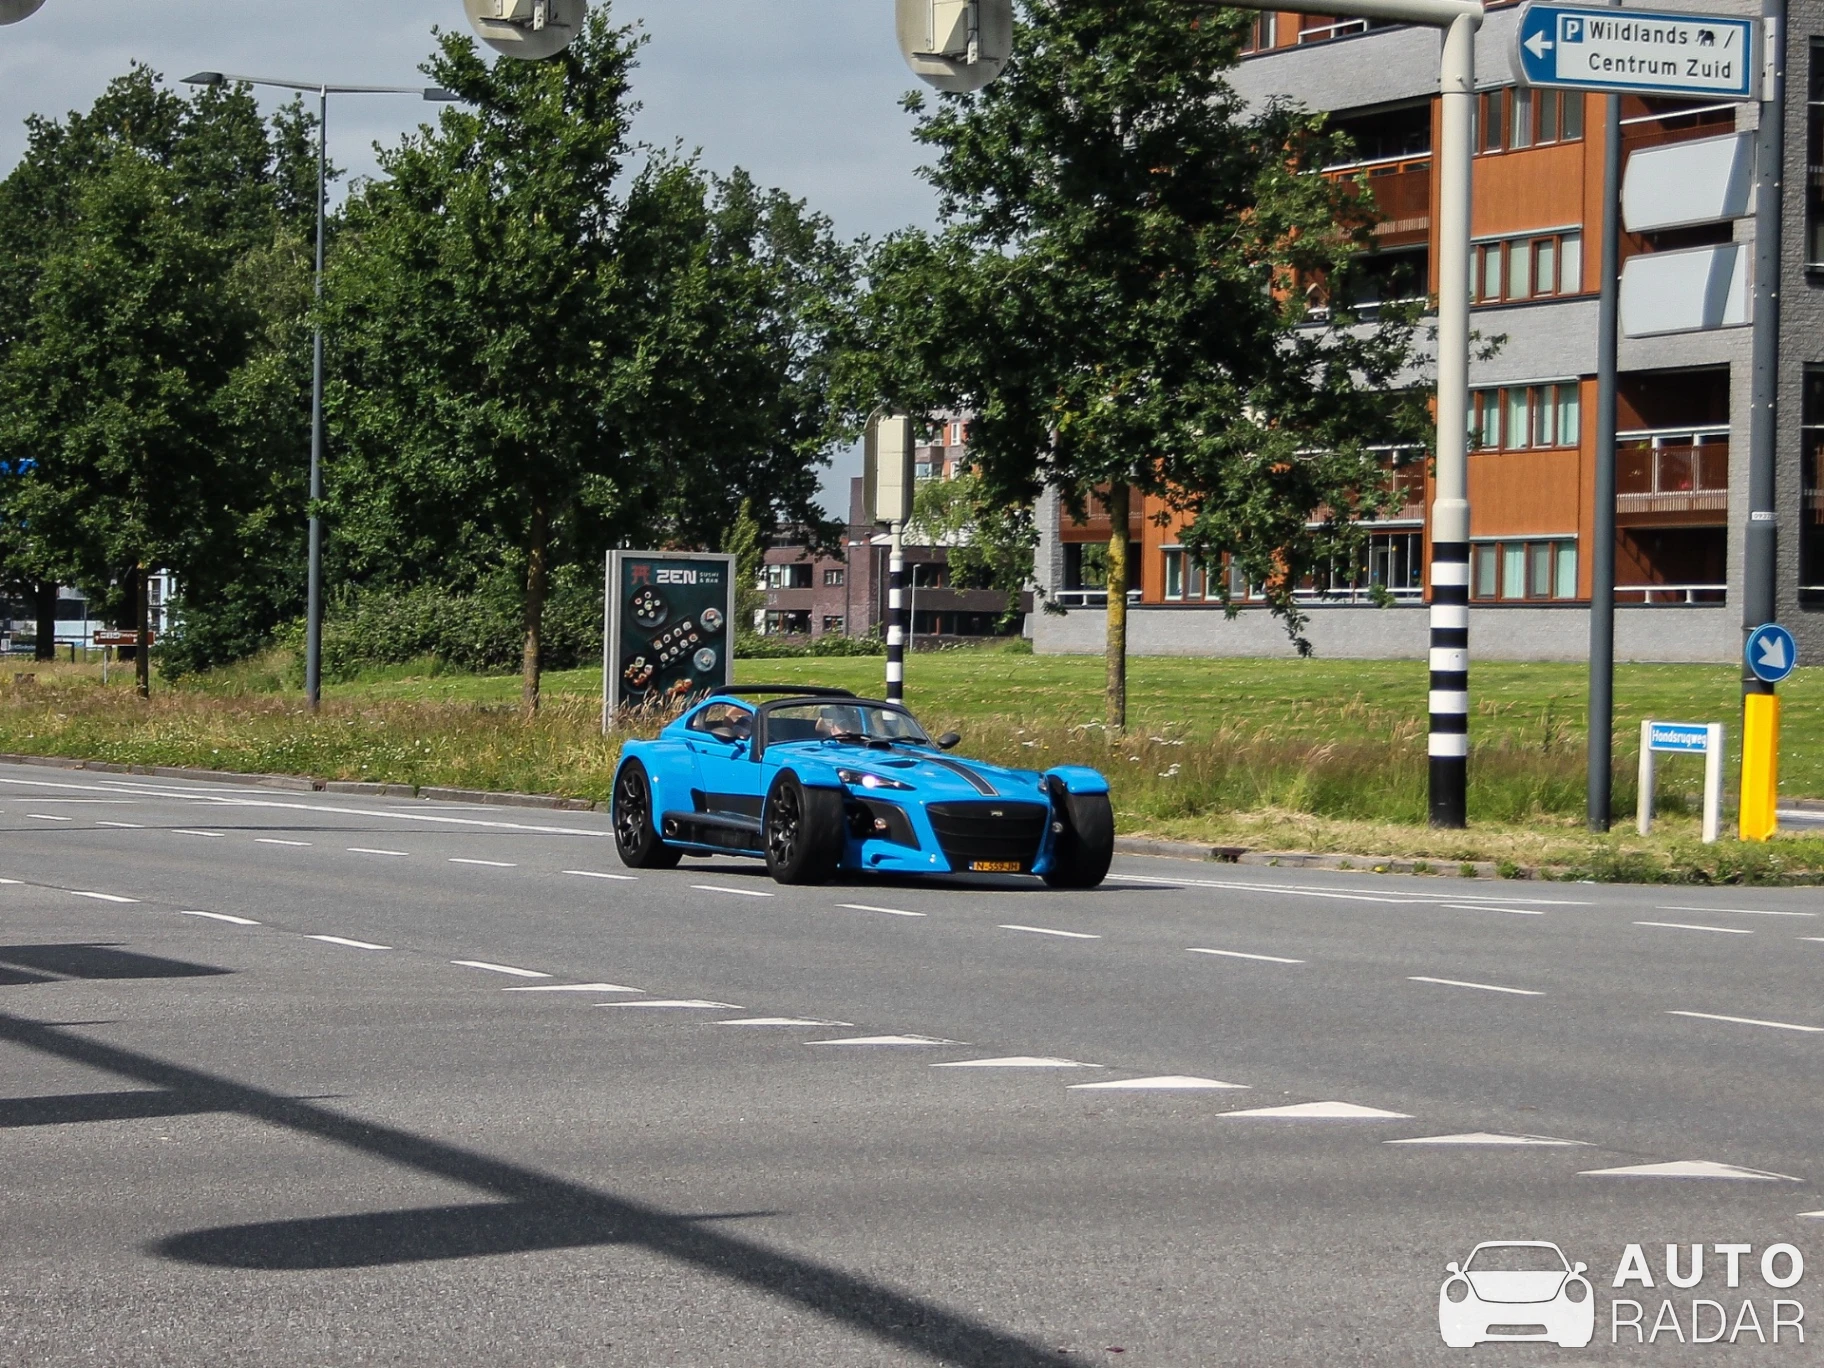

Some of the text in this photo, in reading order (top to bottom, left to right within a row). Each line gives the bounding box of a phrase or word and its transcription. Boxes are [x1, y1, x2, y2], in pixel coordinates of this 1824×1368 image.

[1566, 20, 1580, 40] P
[1589, 21, 1688, 45] Wildlands
[1589, 52, 1731, 79] Centrum Zuid
[656, 569, 697, 585] ZEN
